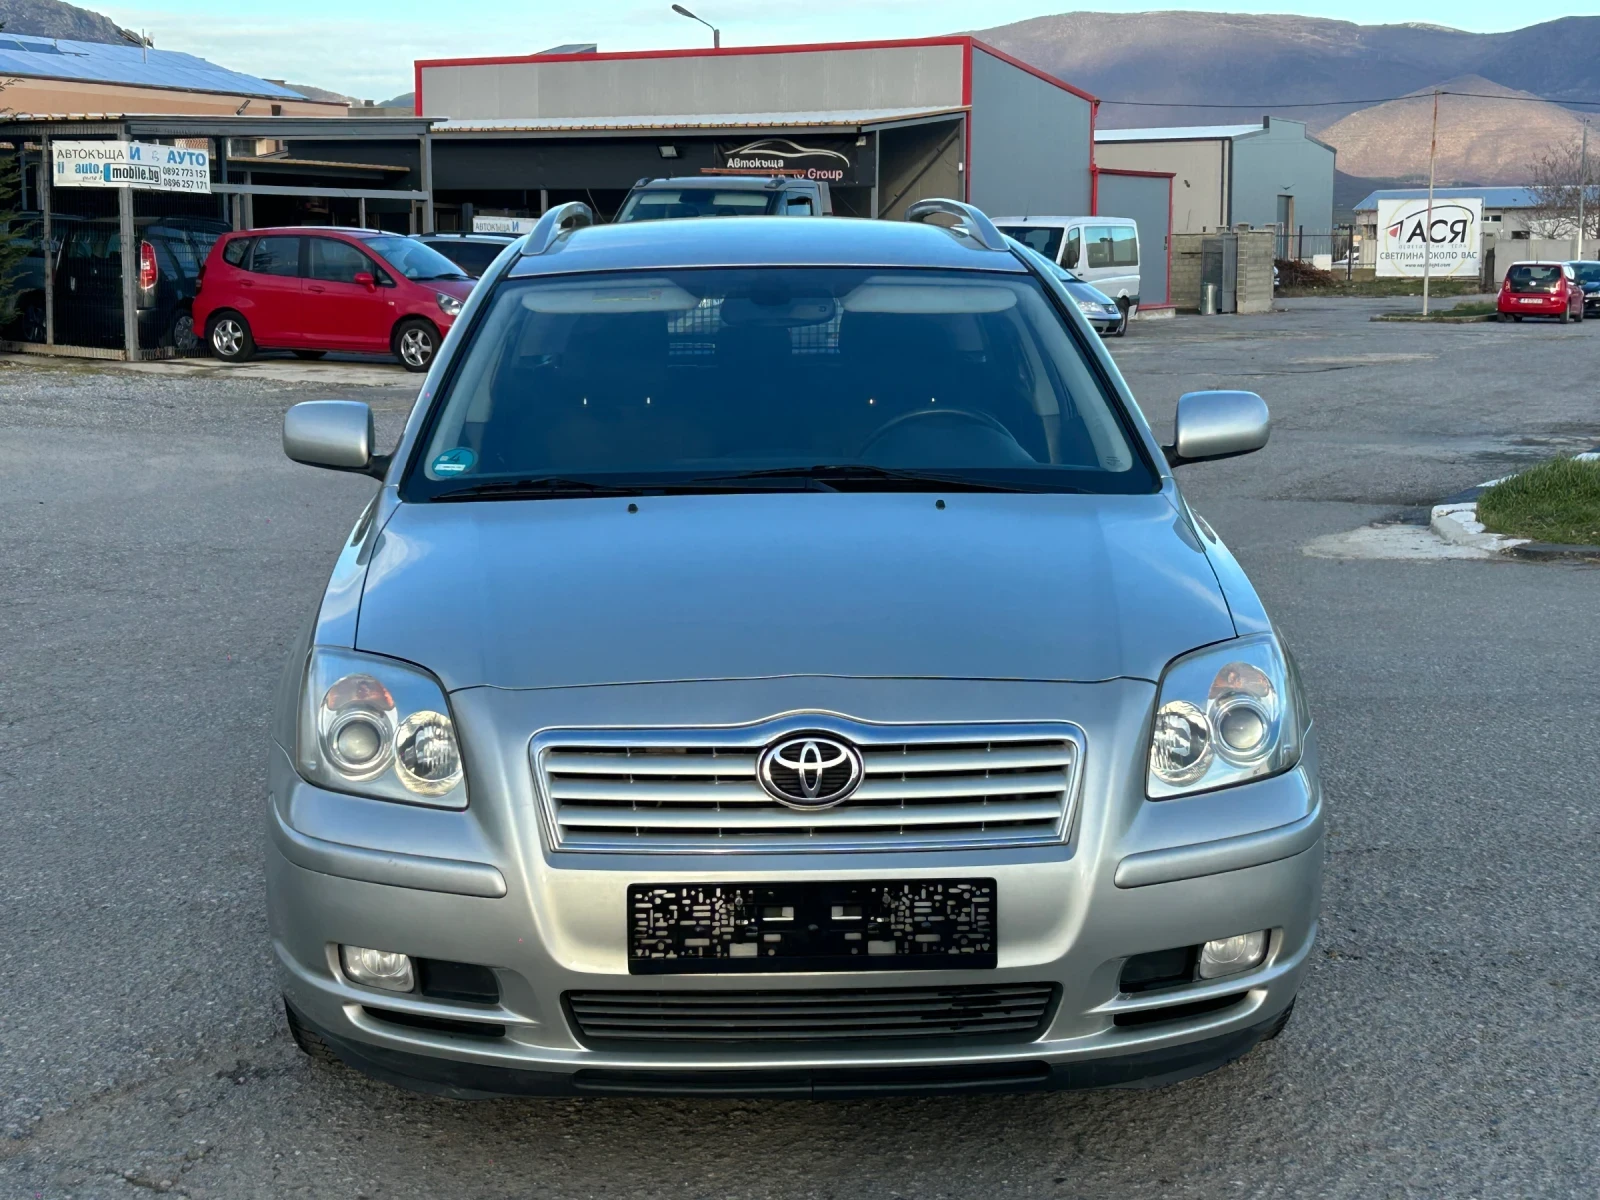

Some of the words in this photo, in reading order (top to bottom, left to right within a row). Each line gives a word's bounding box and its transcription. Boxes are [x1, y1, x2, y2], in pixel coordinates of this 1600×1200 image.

[57, 148, 124, 161] АВТОКЪЩА
[129, 146, 141, 160] И
[167, 150, 206, 166] АУТО
[727, 158, 784, 169] Автокъща
[112, 166, 160, 183] mobile.bg
[163, 167, 180, 177] 0892
[181, 168, 194, 177] 773
[195, 169, 207, 178] 157
[807, 168, 844, 181] Group
[163, 178, 181, 187] 0896
[182, 179, 194, 188] 257
[195, 180, 208, 189] 171
[475, 221, 511, 232] АВТОКЪЩА
[512, 221, 519, 232] И
[1406, 219, 1468, 244] АСЯ
[1380, 251, 1424, 260] СВЕТЛИНА
[1461, 251, 1477, 259] ВАС
